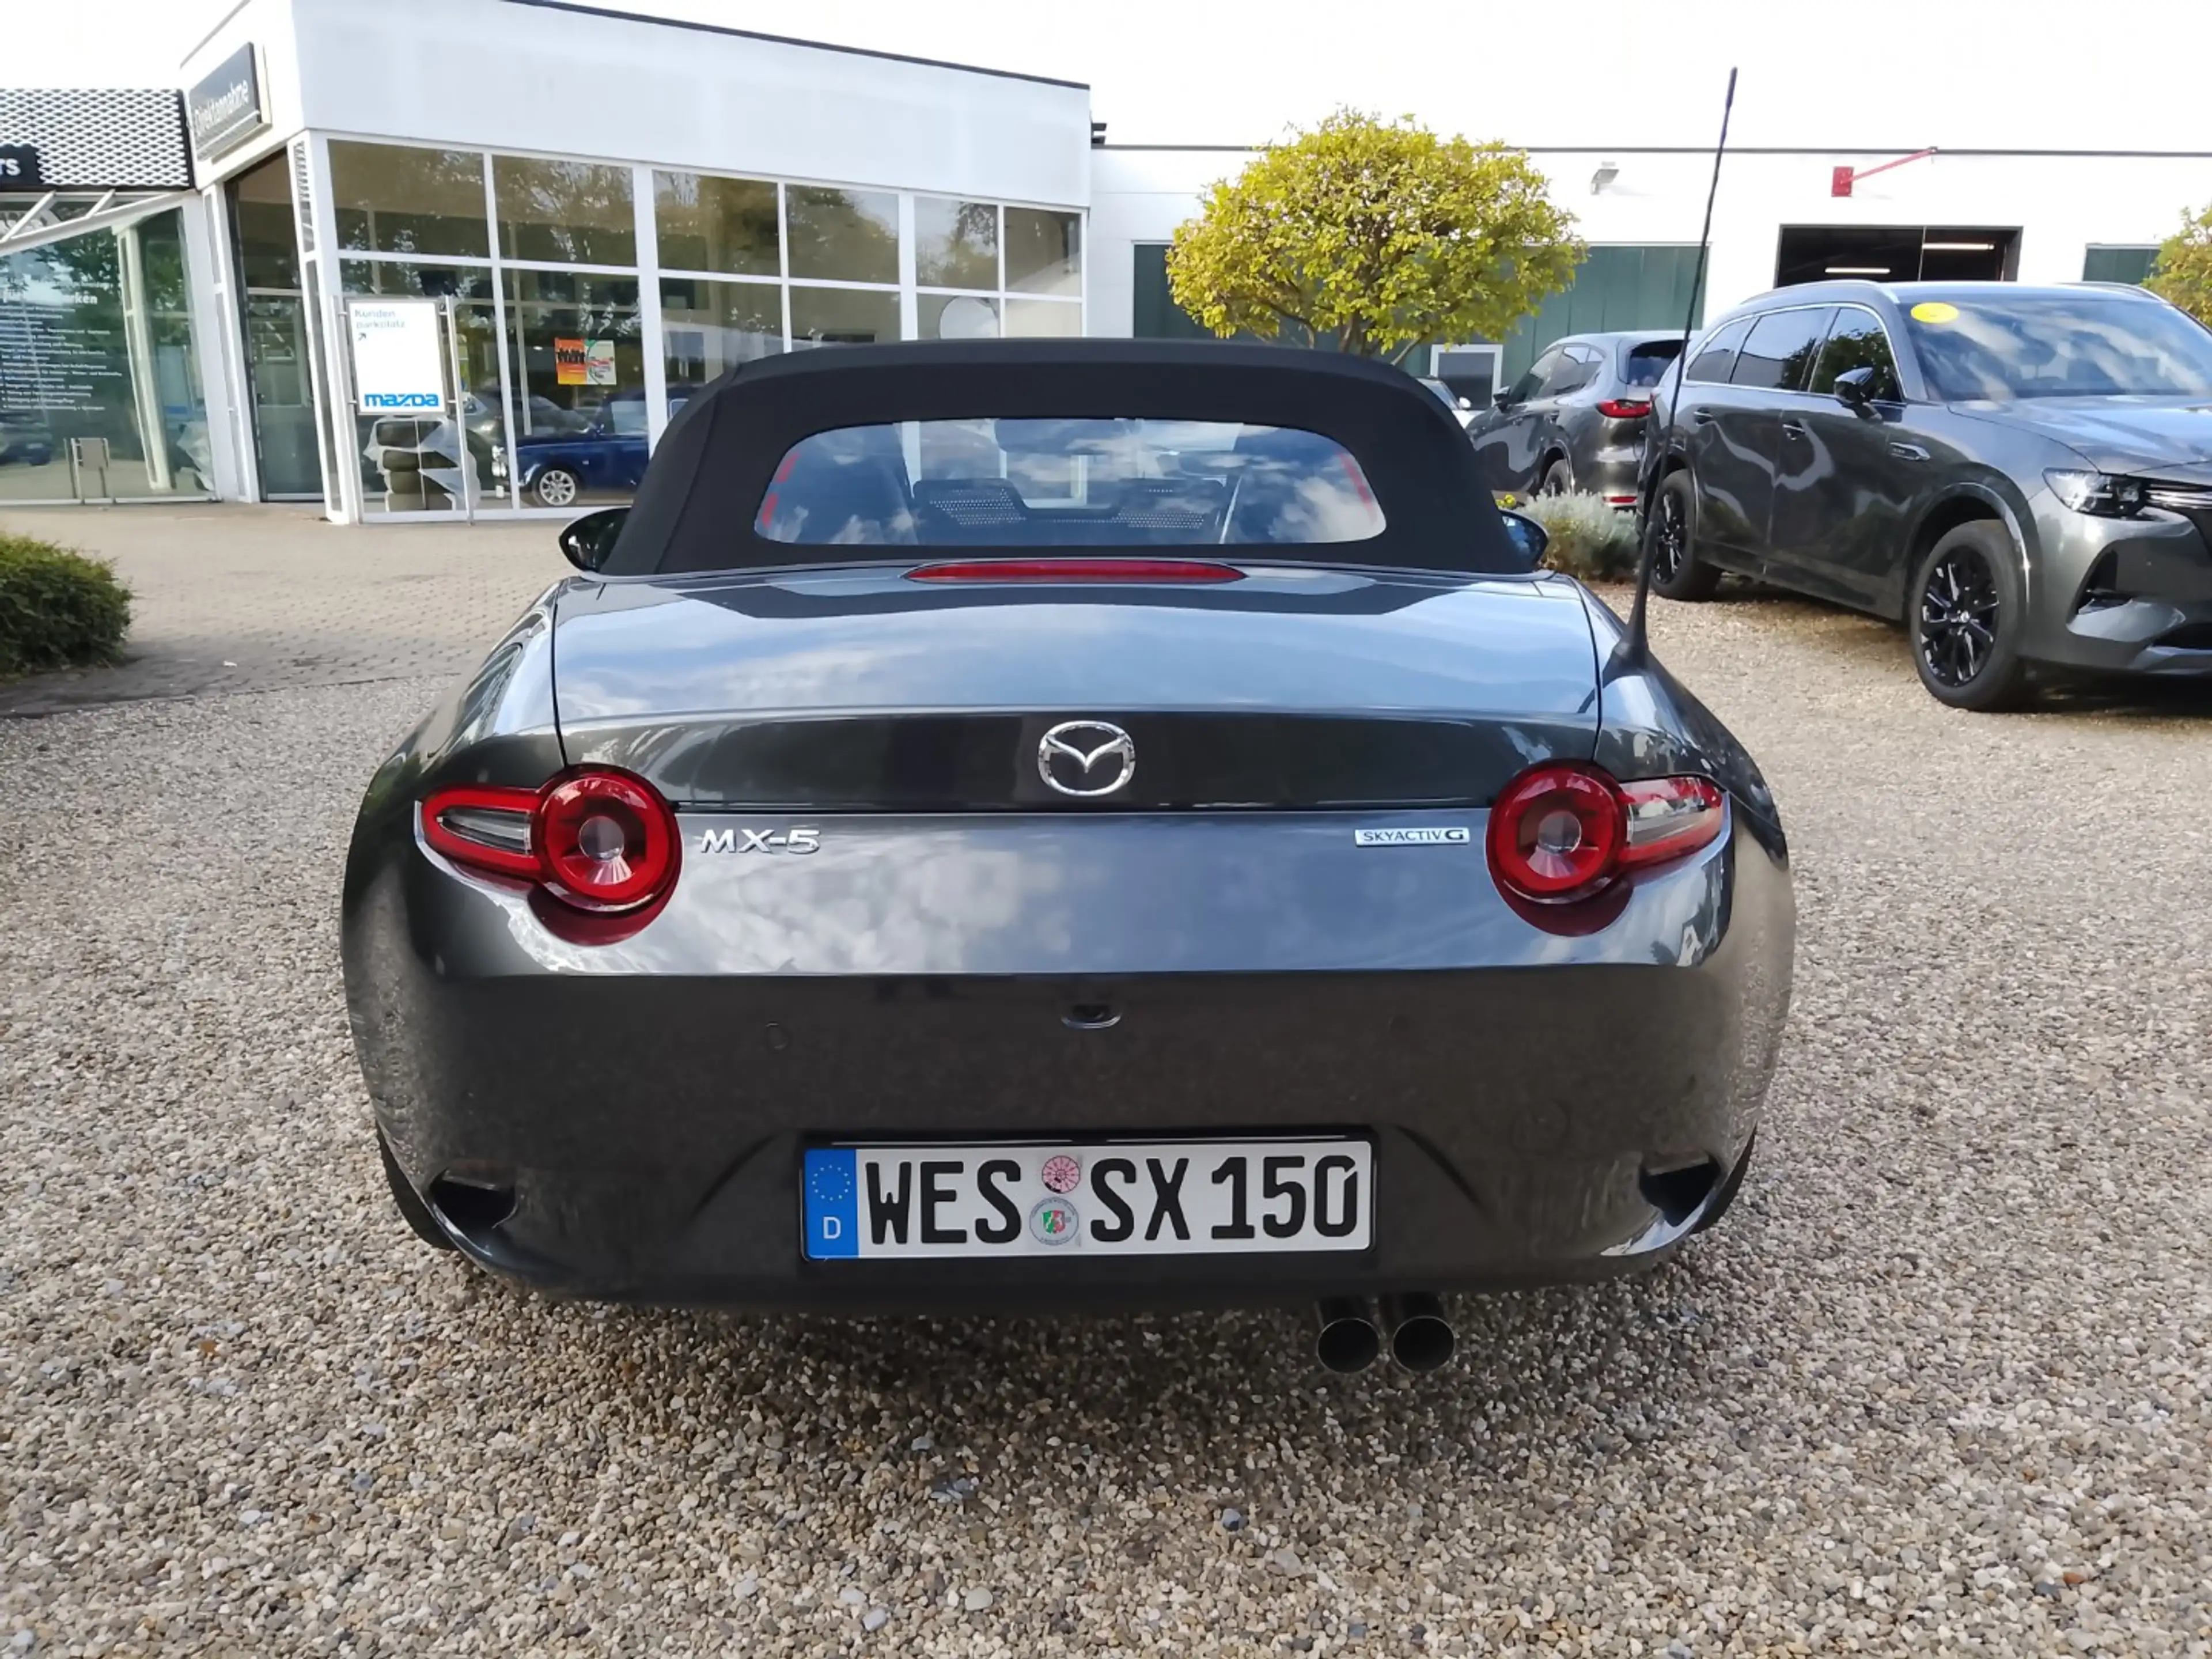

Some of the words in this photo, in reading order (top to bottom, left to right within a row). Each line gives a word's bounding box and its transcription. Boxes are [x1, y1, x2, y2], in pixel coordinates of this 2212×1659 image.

[354, 309, 396, 318] Kunden
[365, 393, 440, 407] mazda
[701, 829, 820, 854] MX-5
[865, 1160, 1022, 1244] WES
[1090, 1158, 1191, 1243] SX
[1211, 1155, 1358, 1239] 150
[823, 1217, 842, 1240] D
